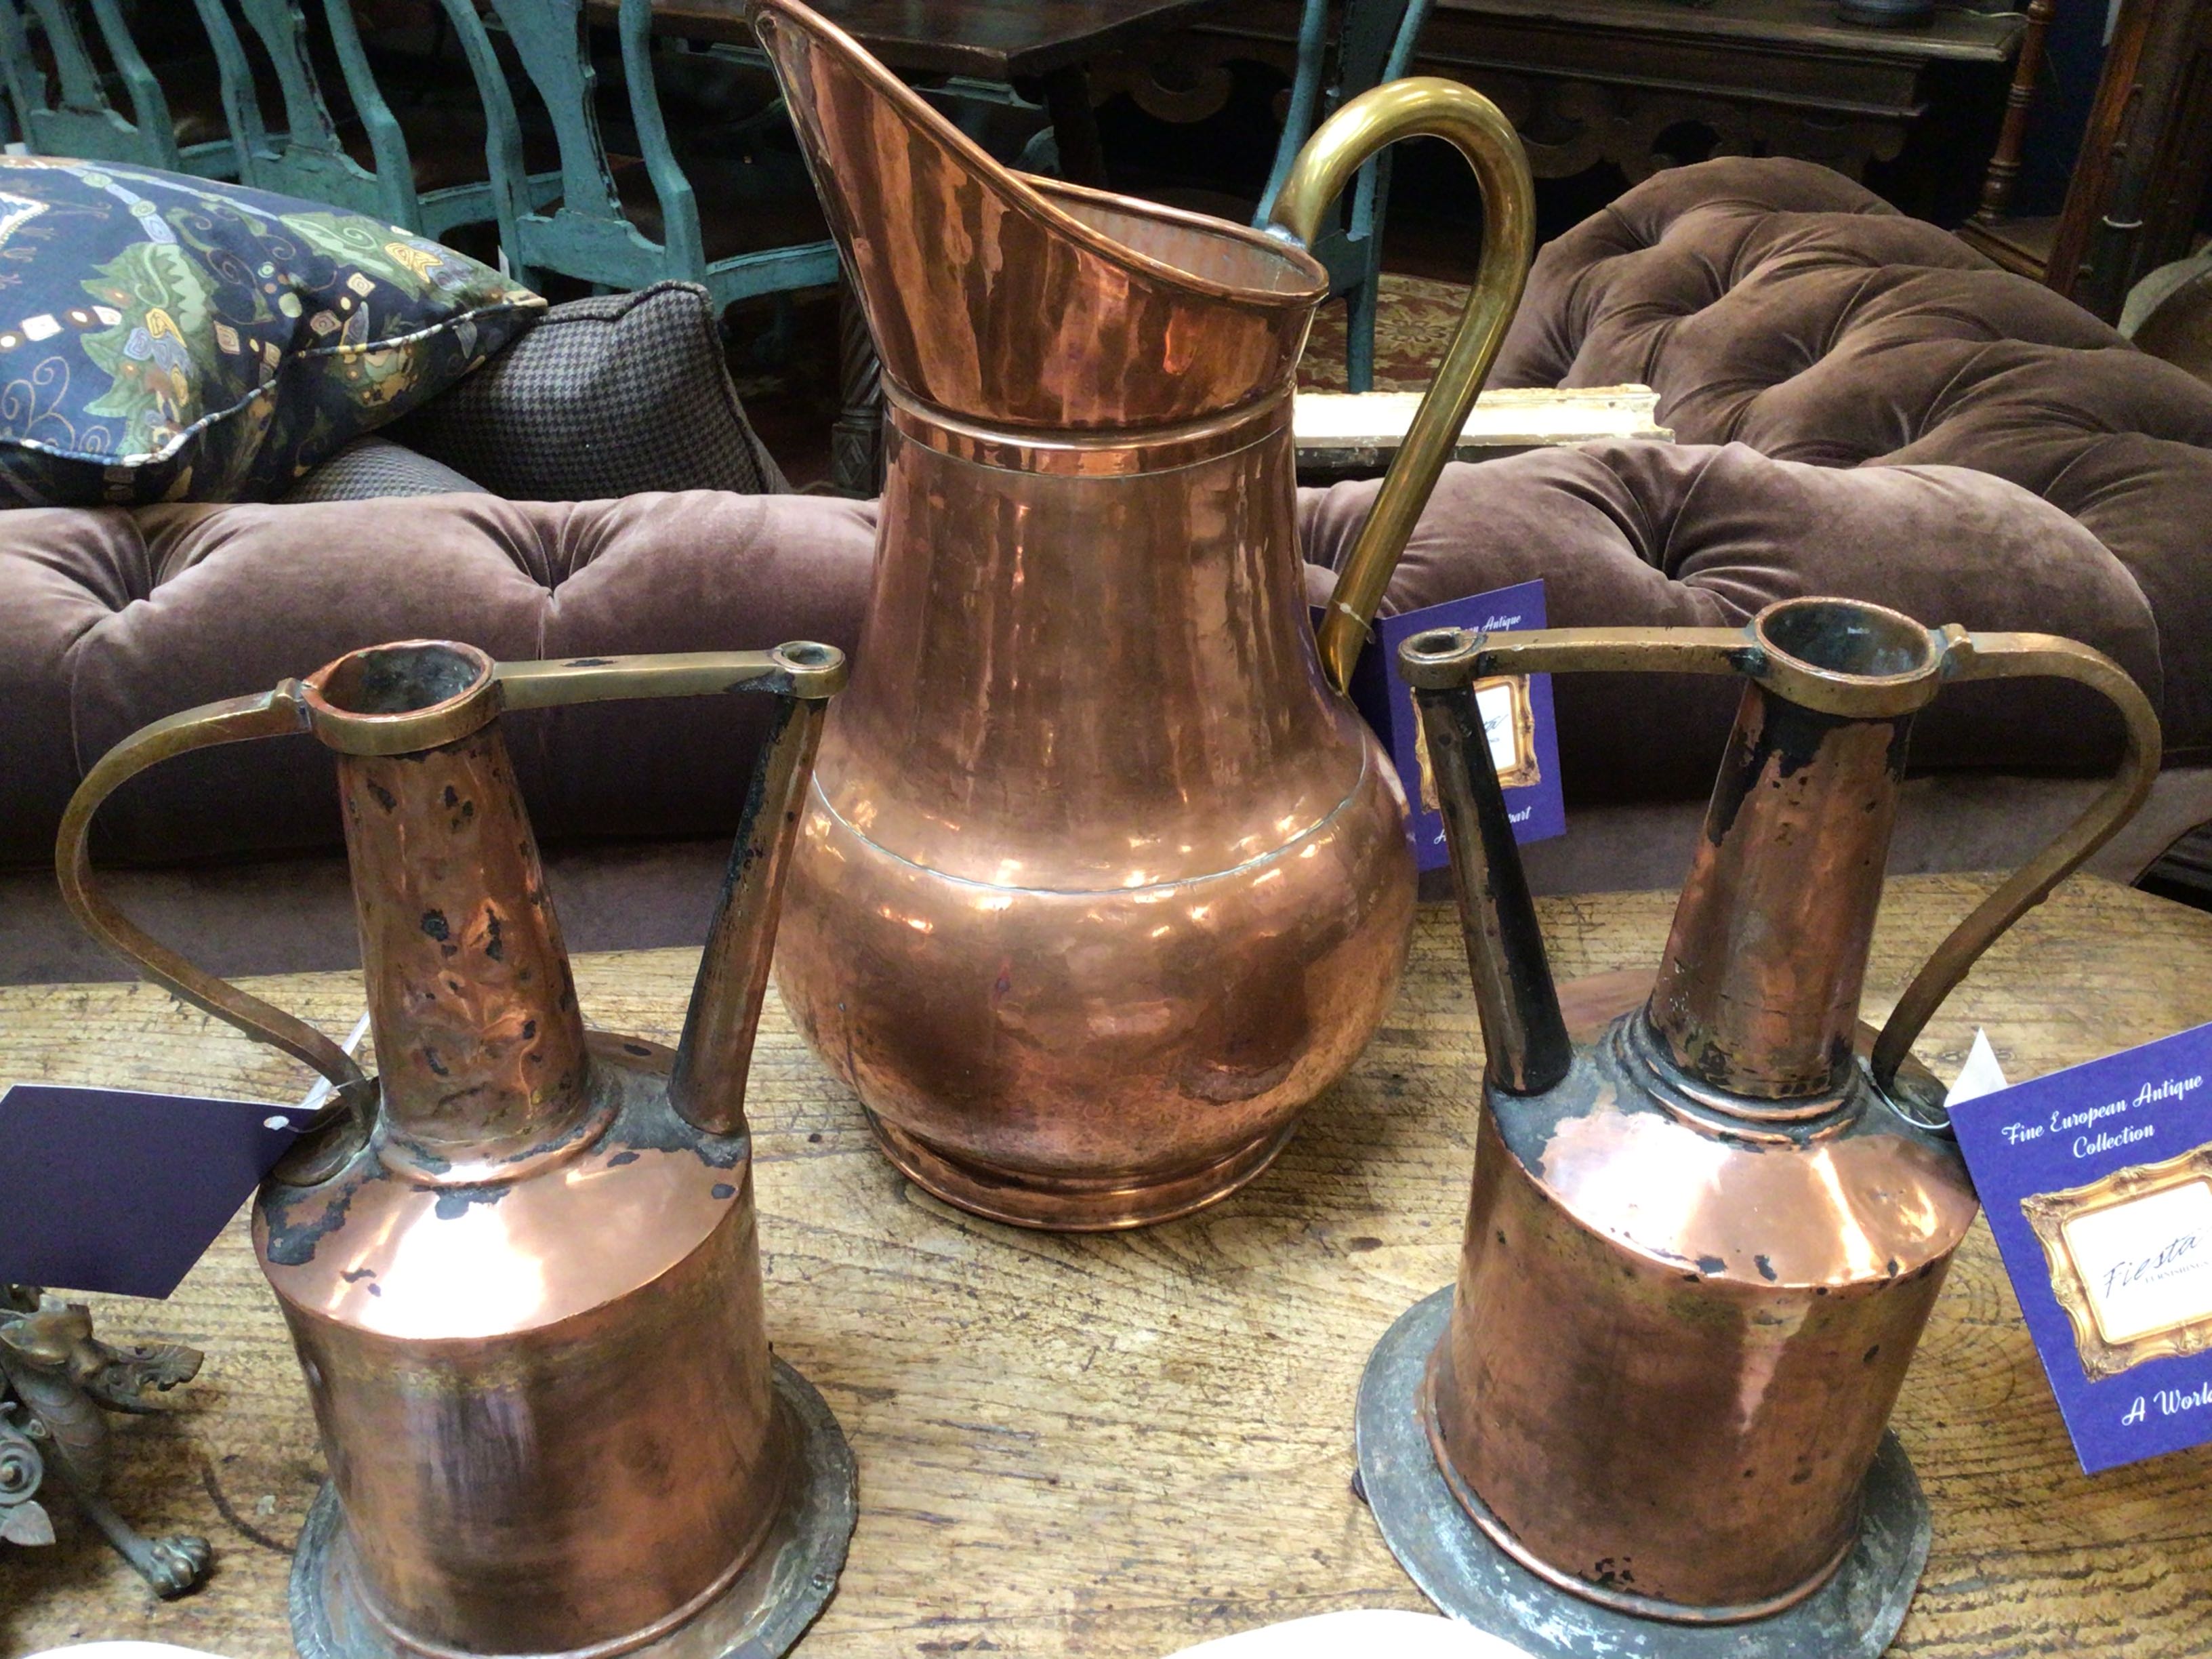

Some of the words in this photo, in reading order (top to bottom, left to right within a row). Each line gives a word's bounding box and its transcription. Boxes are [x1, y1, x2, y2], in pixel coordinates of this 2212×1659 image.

[1481, 615, 1521, 632] Antique
[2001, 1122, 2044, 1145] Fine
[2050, 1099, 2127, 1132] European
[2132, 1075, 2203, 1107] Antique
[2073, 1124, 2155, 1158] Collection
[2103, 1237, 2198, 1298] Fiesta
[2121, 1396, 2146, 1426] A
